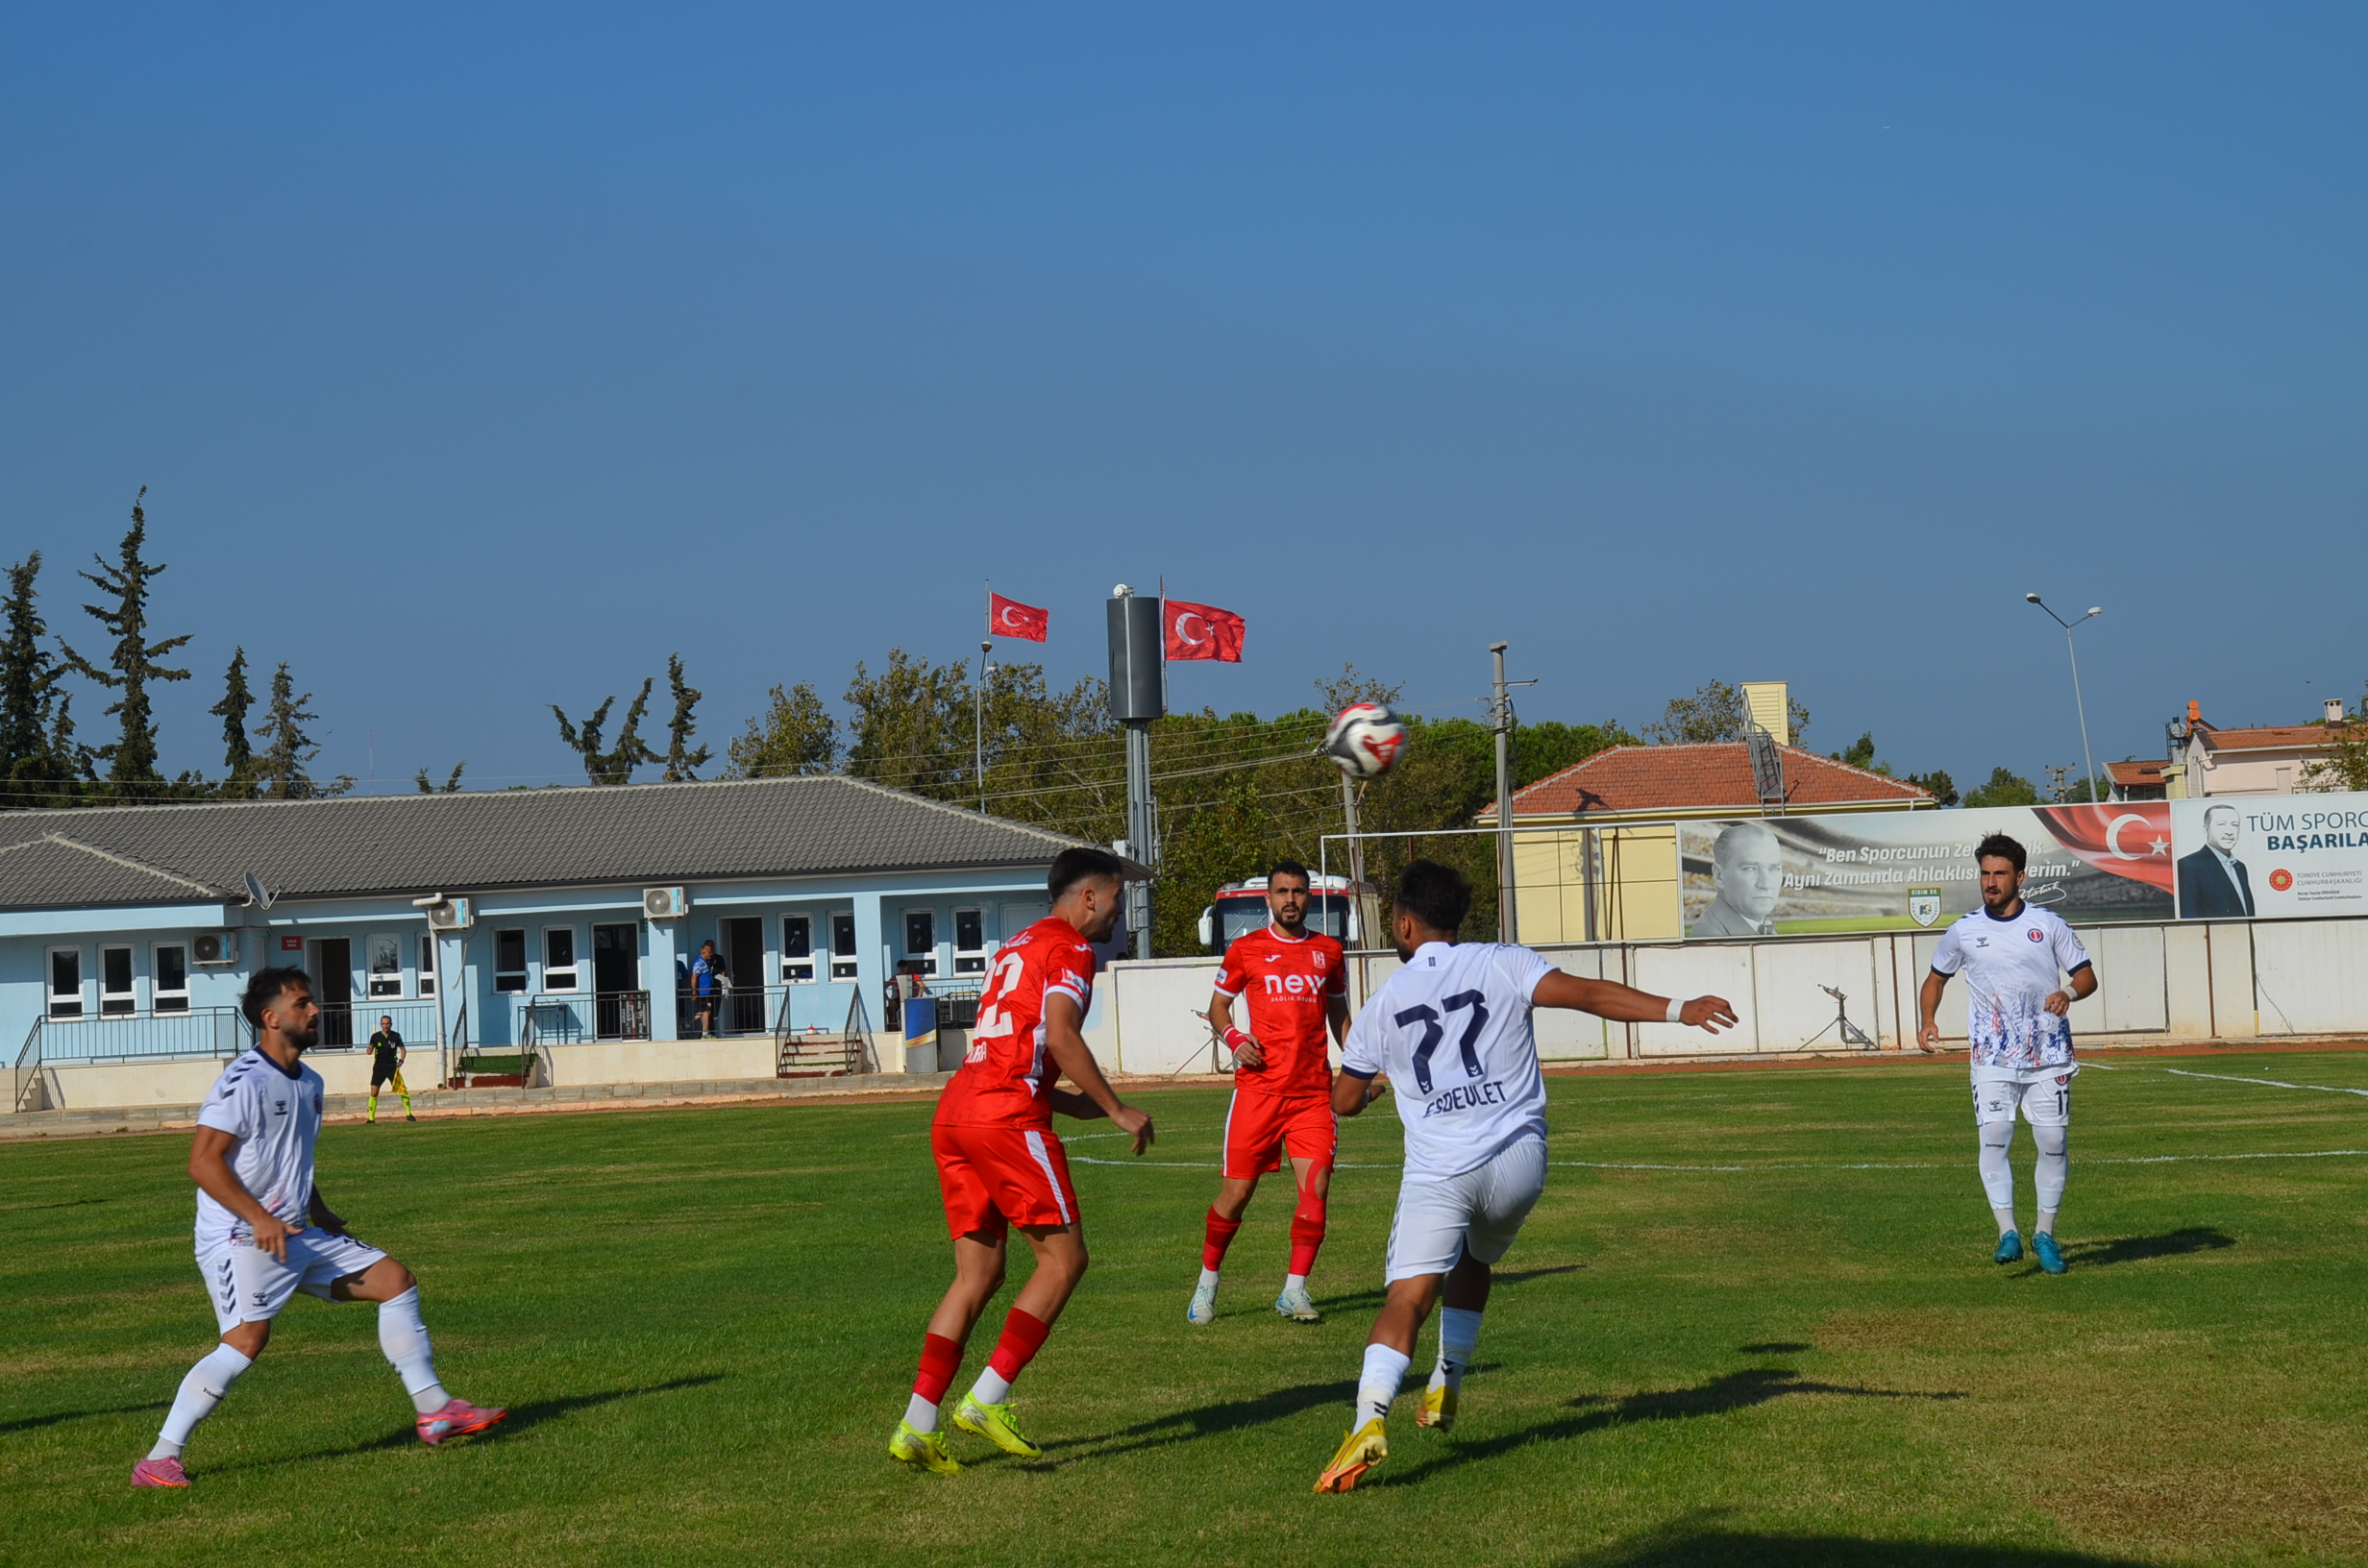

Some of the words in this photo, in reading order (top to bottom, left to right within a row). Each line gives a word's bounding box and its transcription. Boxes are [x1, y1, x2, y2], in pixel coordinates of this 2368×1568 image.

[2246, 812, 2295, 832] TÜM
[1859, 845, 1950, 865] Sporcunun
[1784, 872, 1821, 891] Aynı
[1824, 868, 1904, 886] Zamanda
[2297, 877, 2363, 886] CUMHURBAŞKANLIĞI
[1394, 989, 1491, 1096] 77
[1423, 1081, 1507, 1119] ESDEVLET
